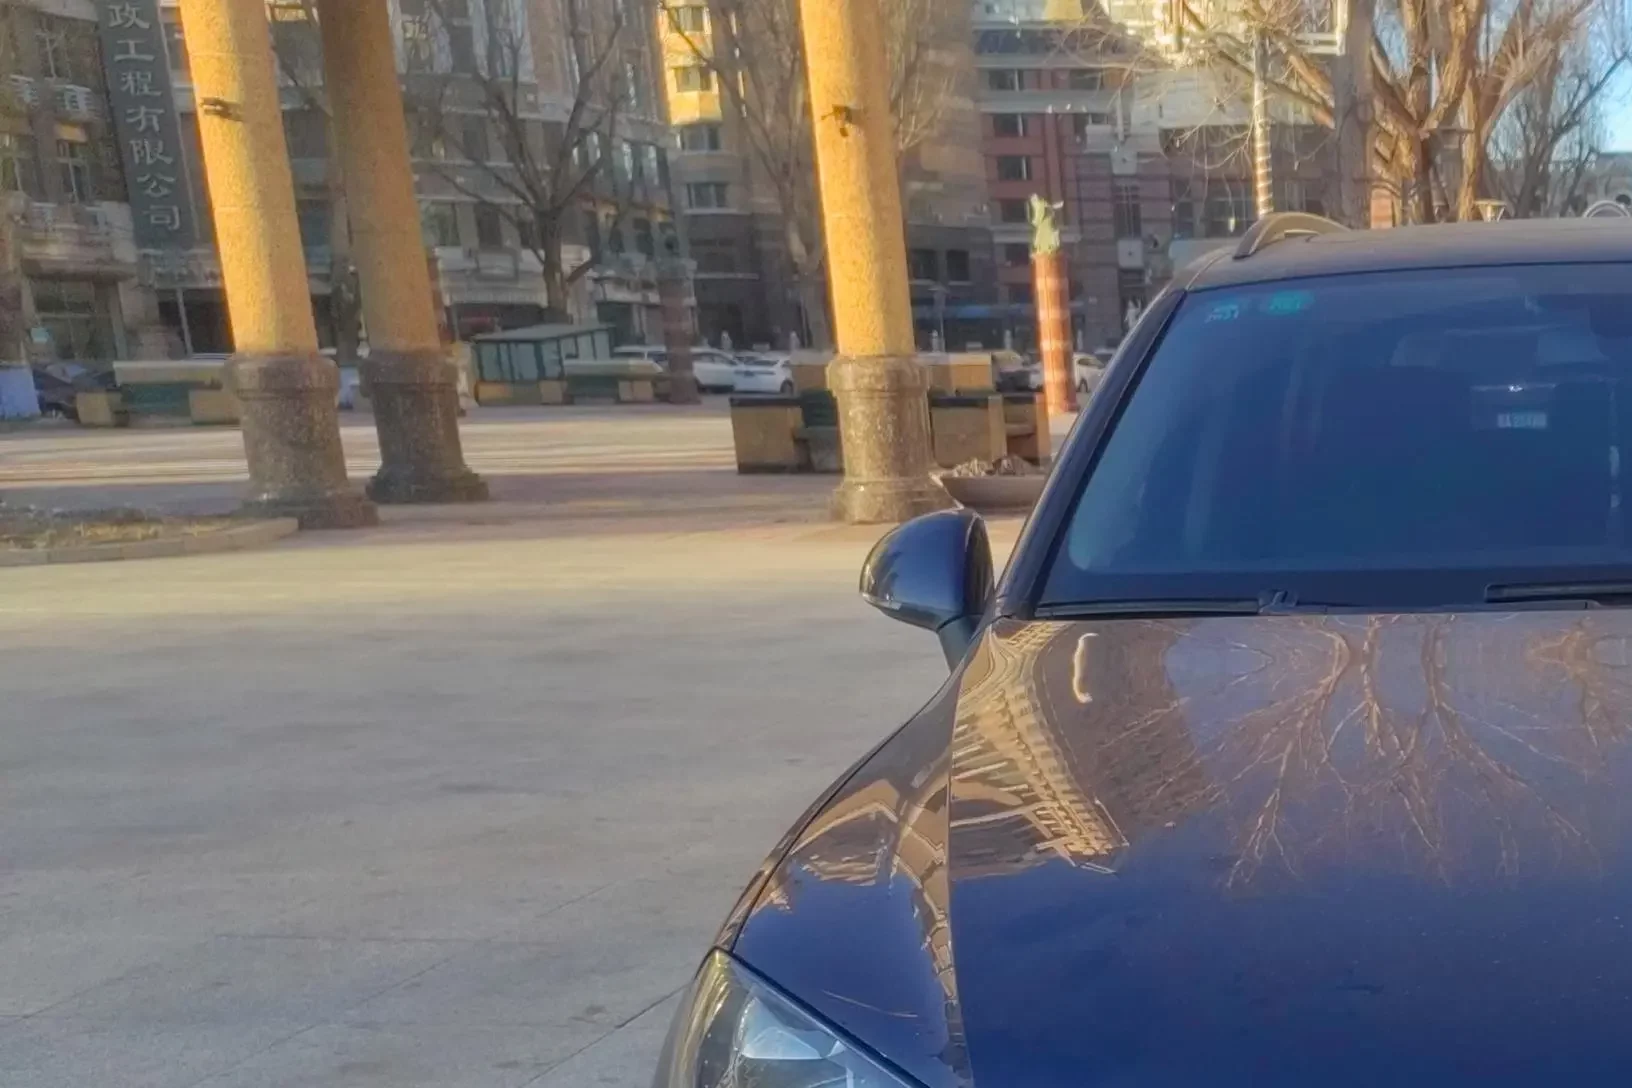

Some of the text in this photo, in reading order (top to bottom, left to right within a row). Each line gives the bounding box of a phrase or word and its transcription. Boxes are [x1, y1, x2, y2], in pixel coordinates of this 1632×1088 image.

[107, 2, 181, 231] 政工程有限公司
